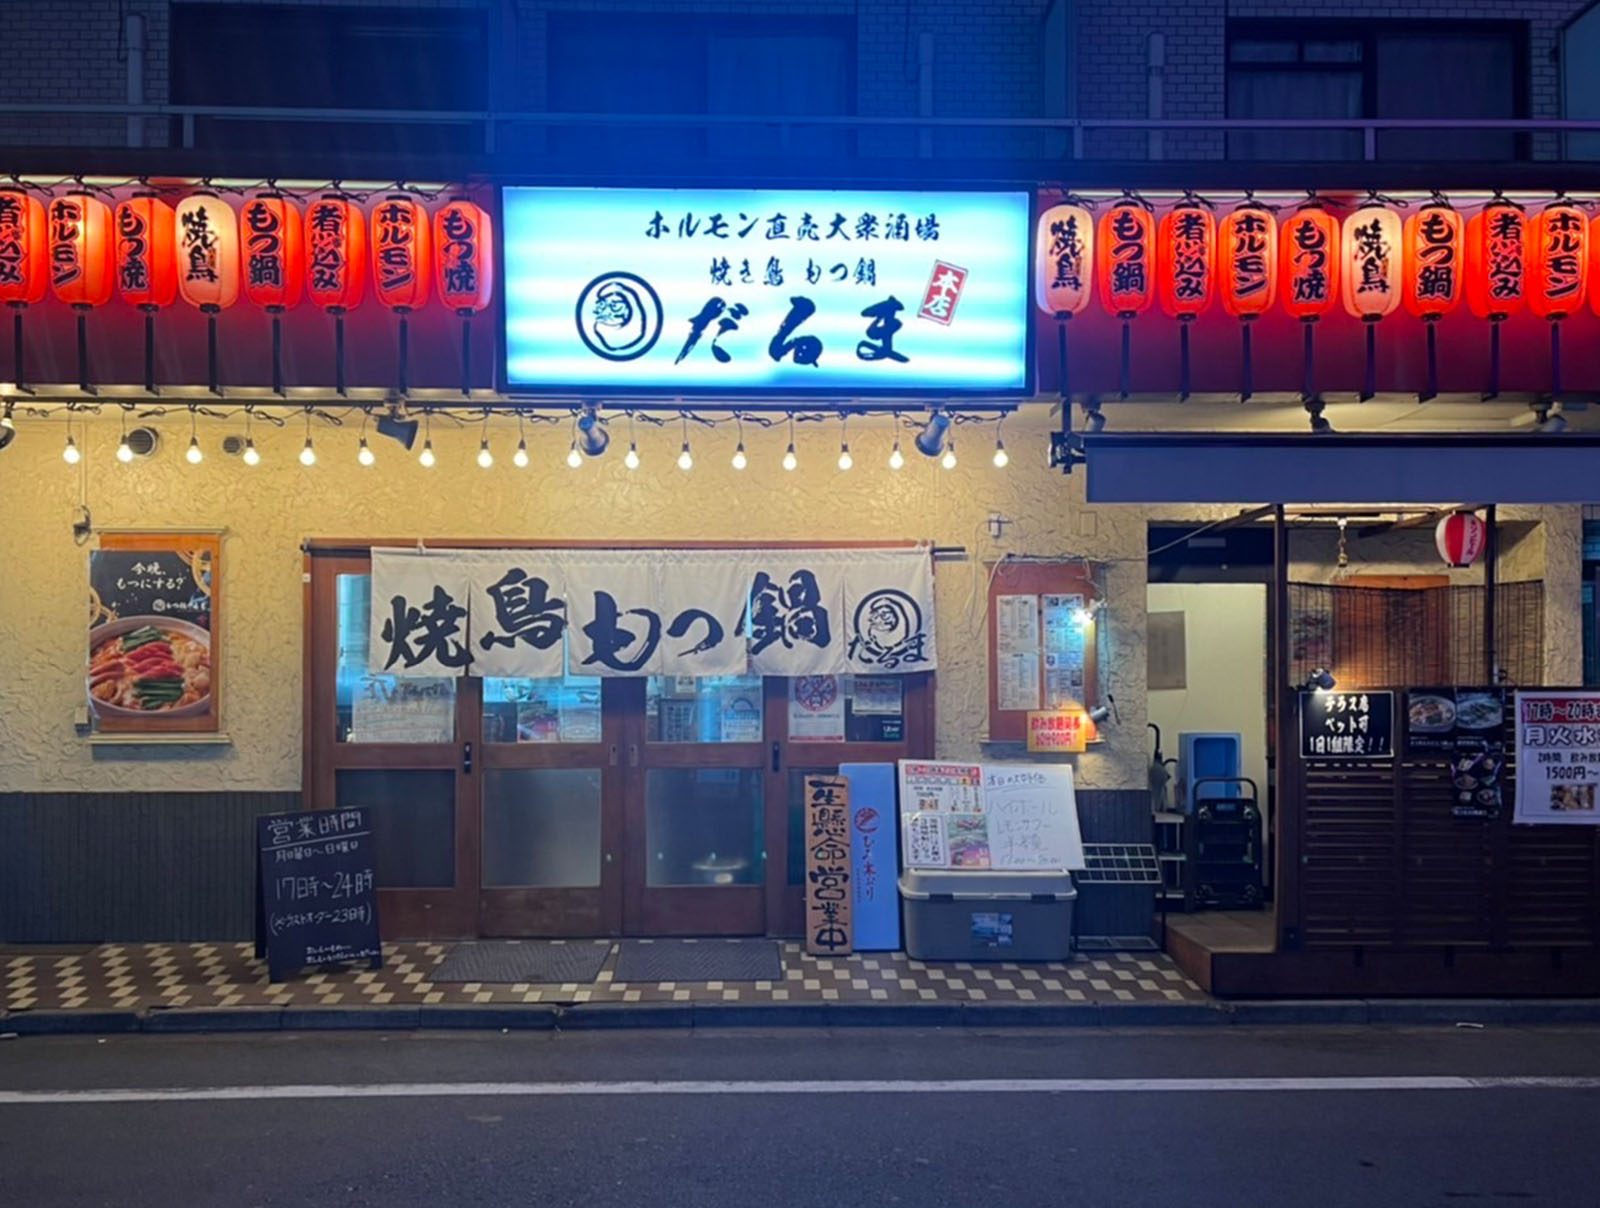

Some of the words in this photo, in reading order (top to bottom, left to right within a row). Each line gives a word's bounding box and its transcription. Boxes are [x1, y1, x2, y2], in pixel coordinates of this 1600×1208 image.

[52, 201, 79, 285] ホルモン
[120, 206, 146, 290] もつ焼
[182, 205, 219, 283] 焼鳥
[247, 203, 280, 286] もつ鍋
[312, 205, 342, 290] 煮込み
[380, 204, 411, 289] ホルモン
[443, 210, 475, 293] もつ焼
[645, 210, 940, 241] ホルモン直売大衆酒場
[1050, 215, 1084, 291] 焼鳥
[1112, 211, 1145, 293] もつ鍋
[1175, 213, 1206, 298] 煮込み
[1235, 214, 1267, 297] ホルモン
[1294, 220, 1326, 300] もつ焼
[1354, 218, 1390, 294] 焼鳥
[1418, 214, 1454, 298] もつ鍋
[1490, 213, 1523, 299] 煮込み
[1546, 213, 1580, 297] ホルモン
[806, 257, 876, 287] もつ鍋
[924, 270, 960, 318] 本店
[675, 295, 909, 368] だるま
[1523, 725, 1600, 746] 月火水
[1526, 702, 1600, 720] 17時～20時
[267, 811, 362, 845] 営業時間
[808, 780, 850, 951] 一生懸命営業中
